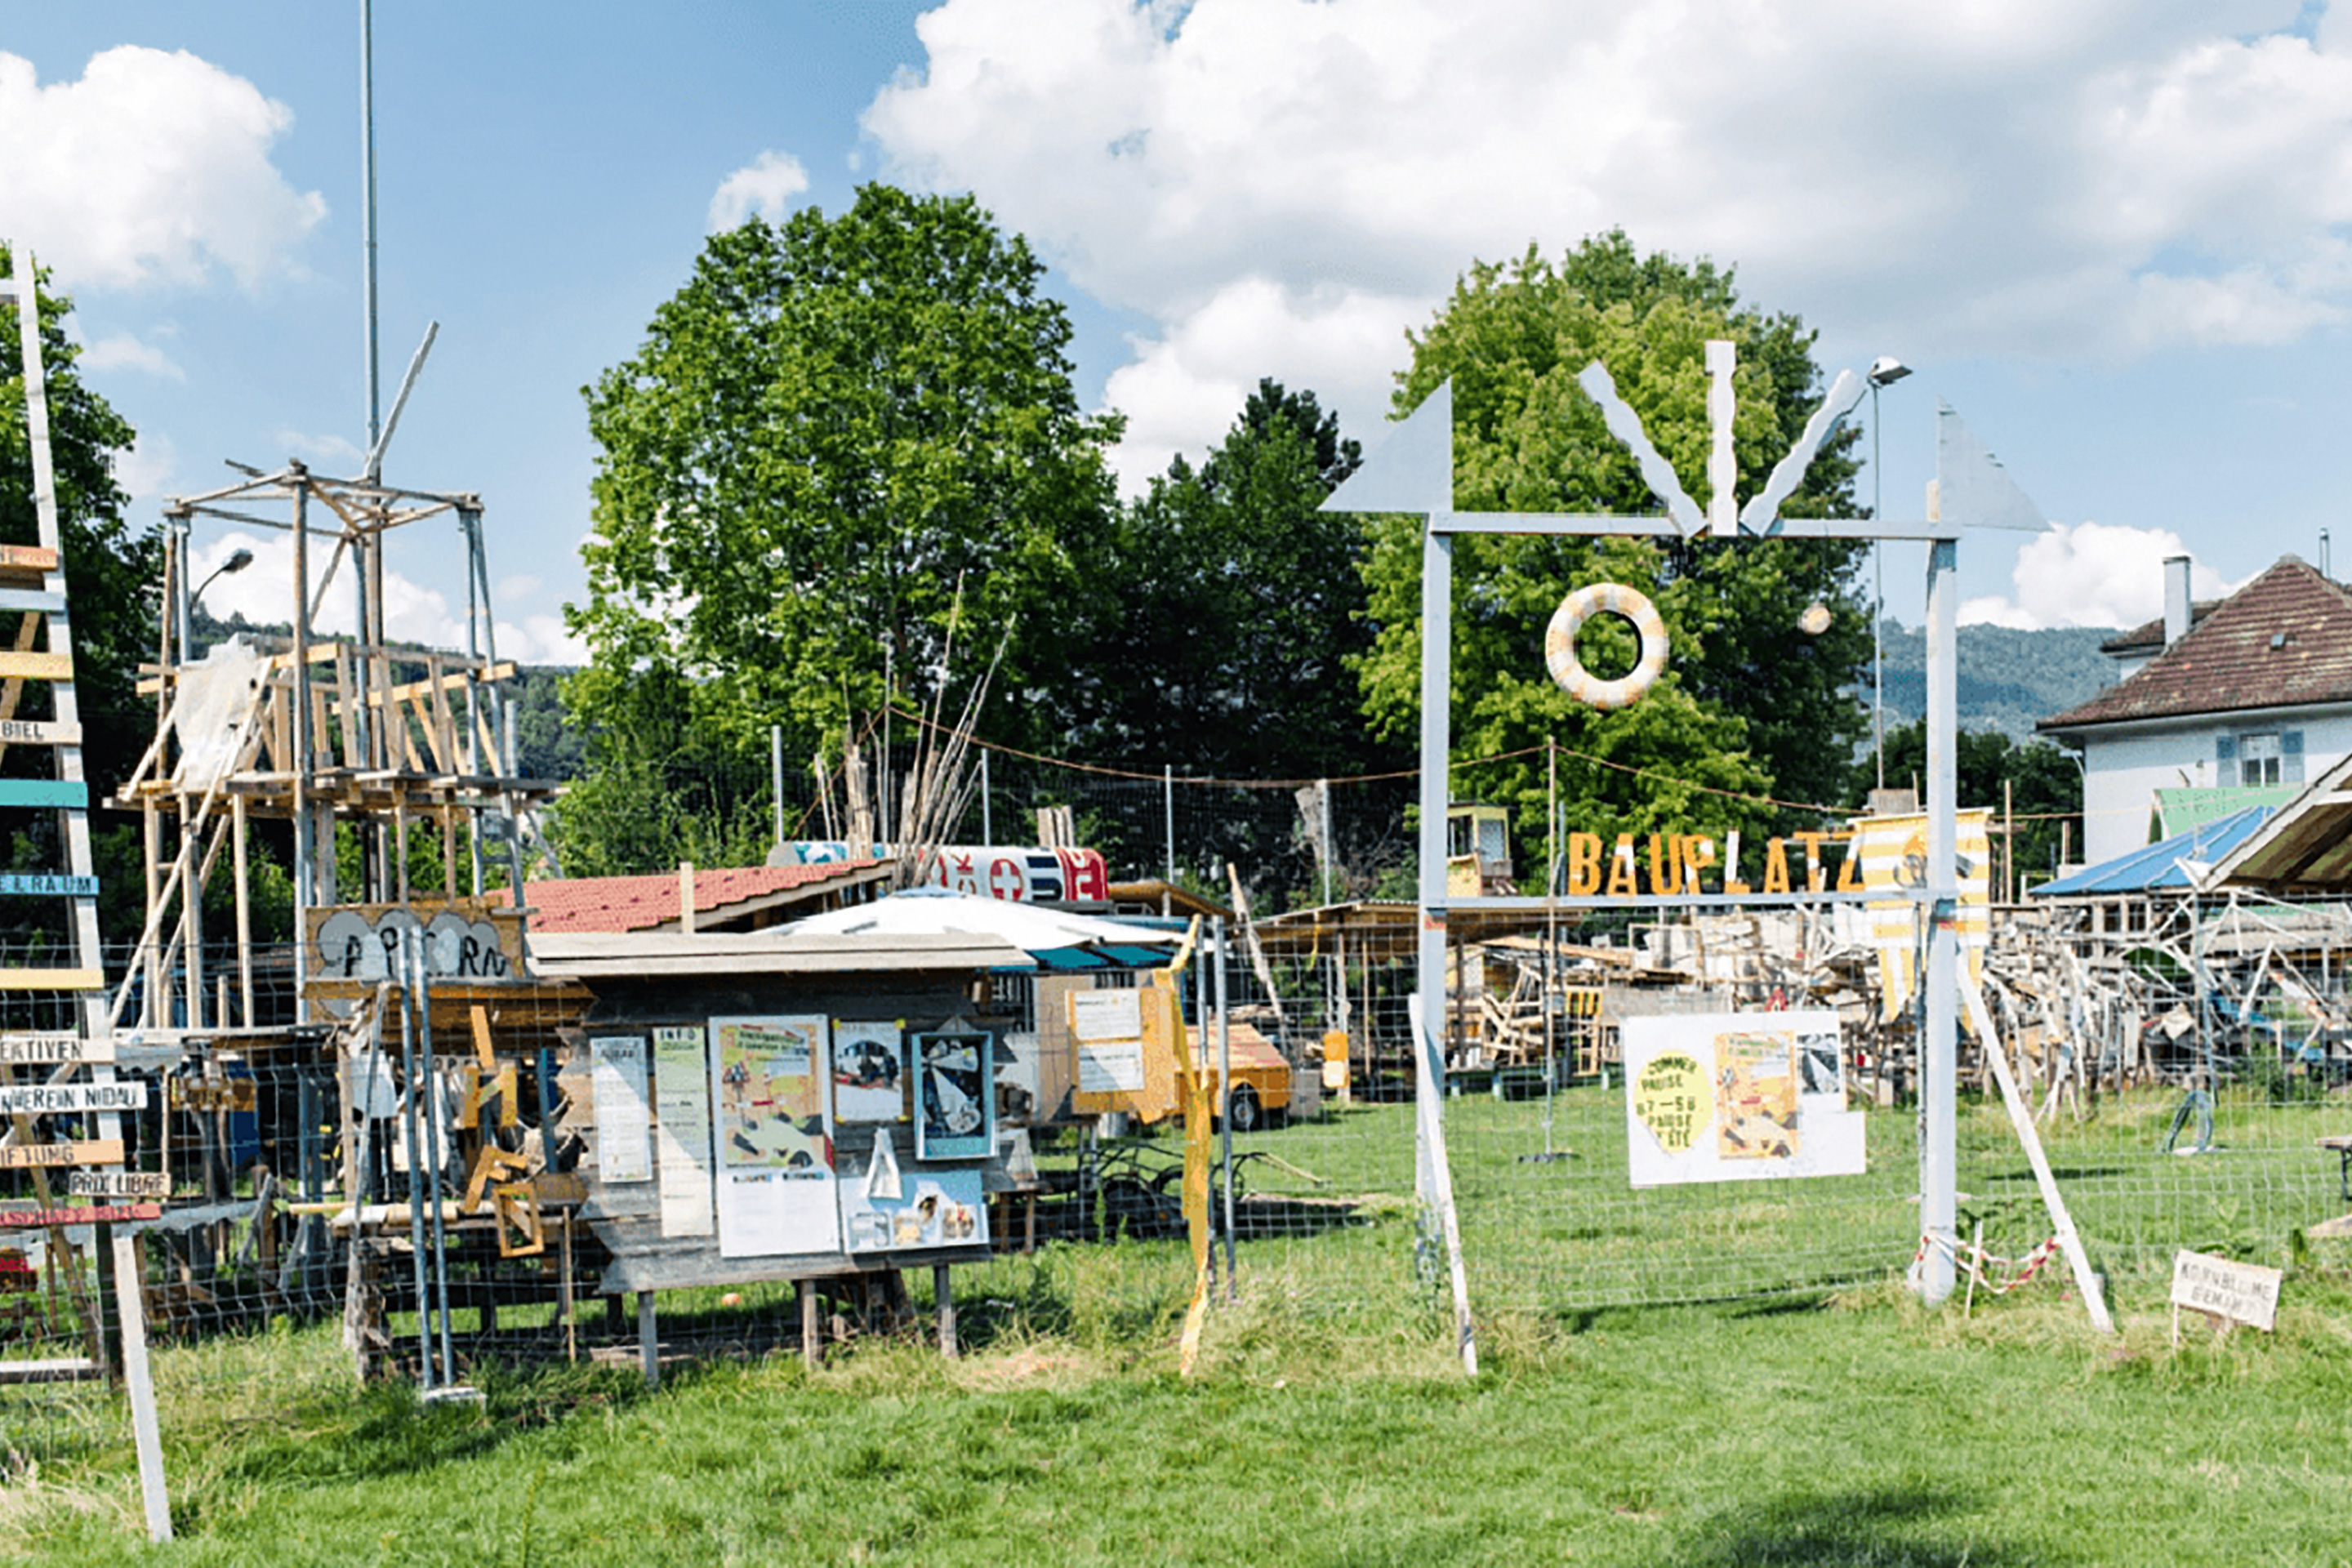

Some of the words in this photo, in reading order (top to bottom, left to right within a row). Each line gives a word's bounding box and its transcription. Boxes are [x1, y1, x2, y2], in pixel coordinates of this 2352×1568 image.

[2, 720, 45, 742] BIEL
[1568, 828, 1866, 896] BAUPLATZ
[72, 1174, 110, 1193] PRIX
[116, 1174, 167, 1193] LIBRE
